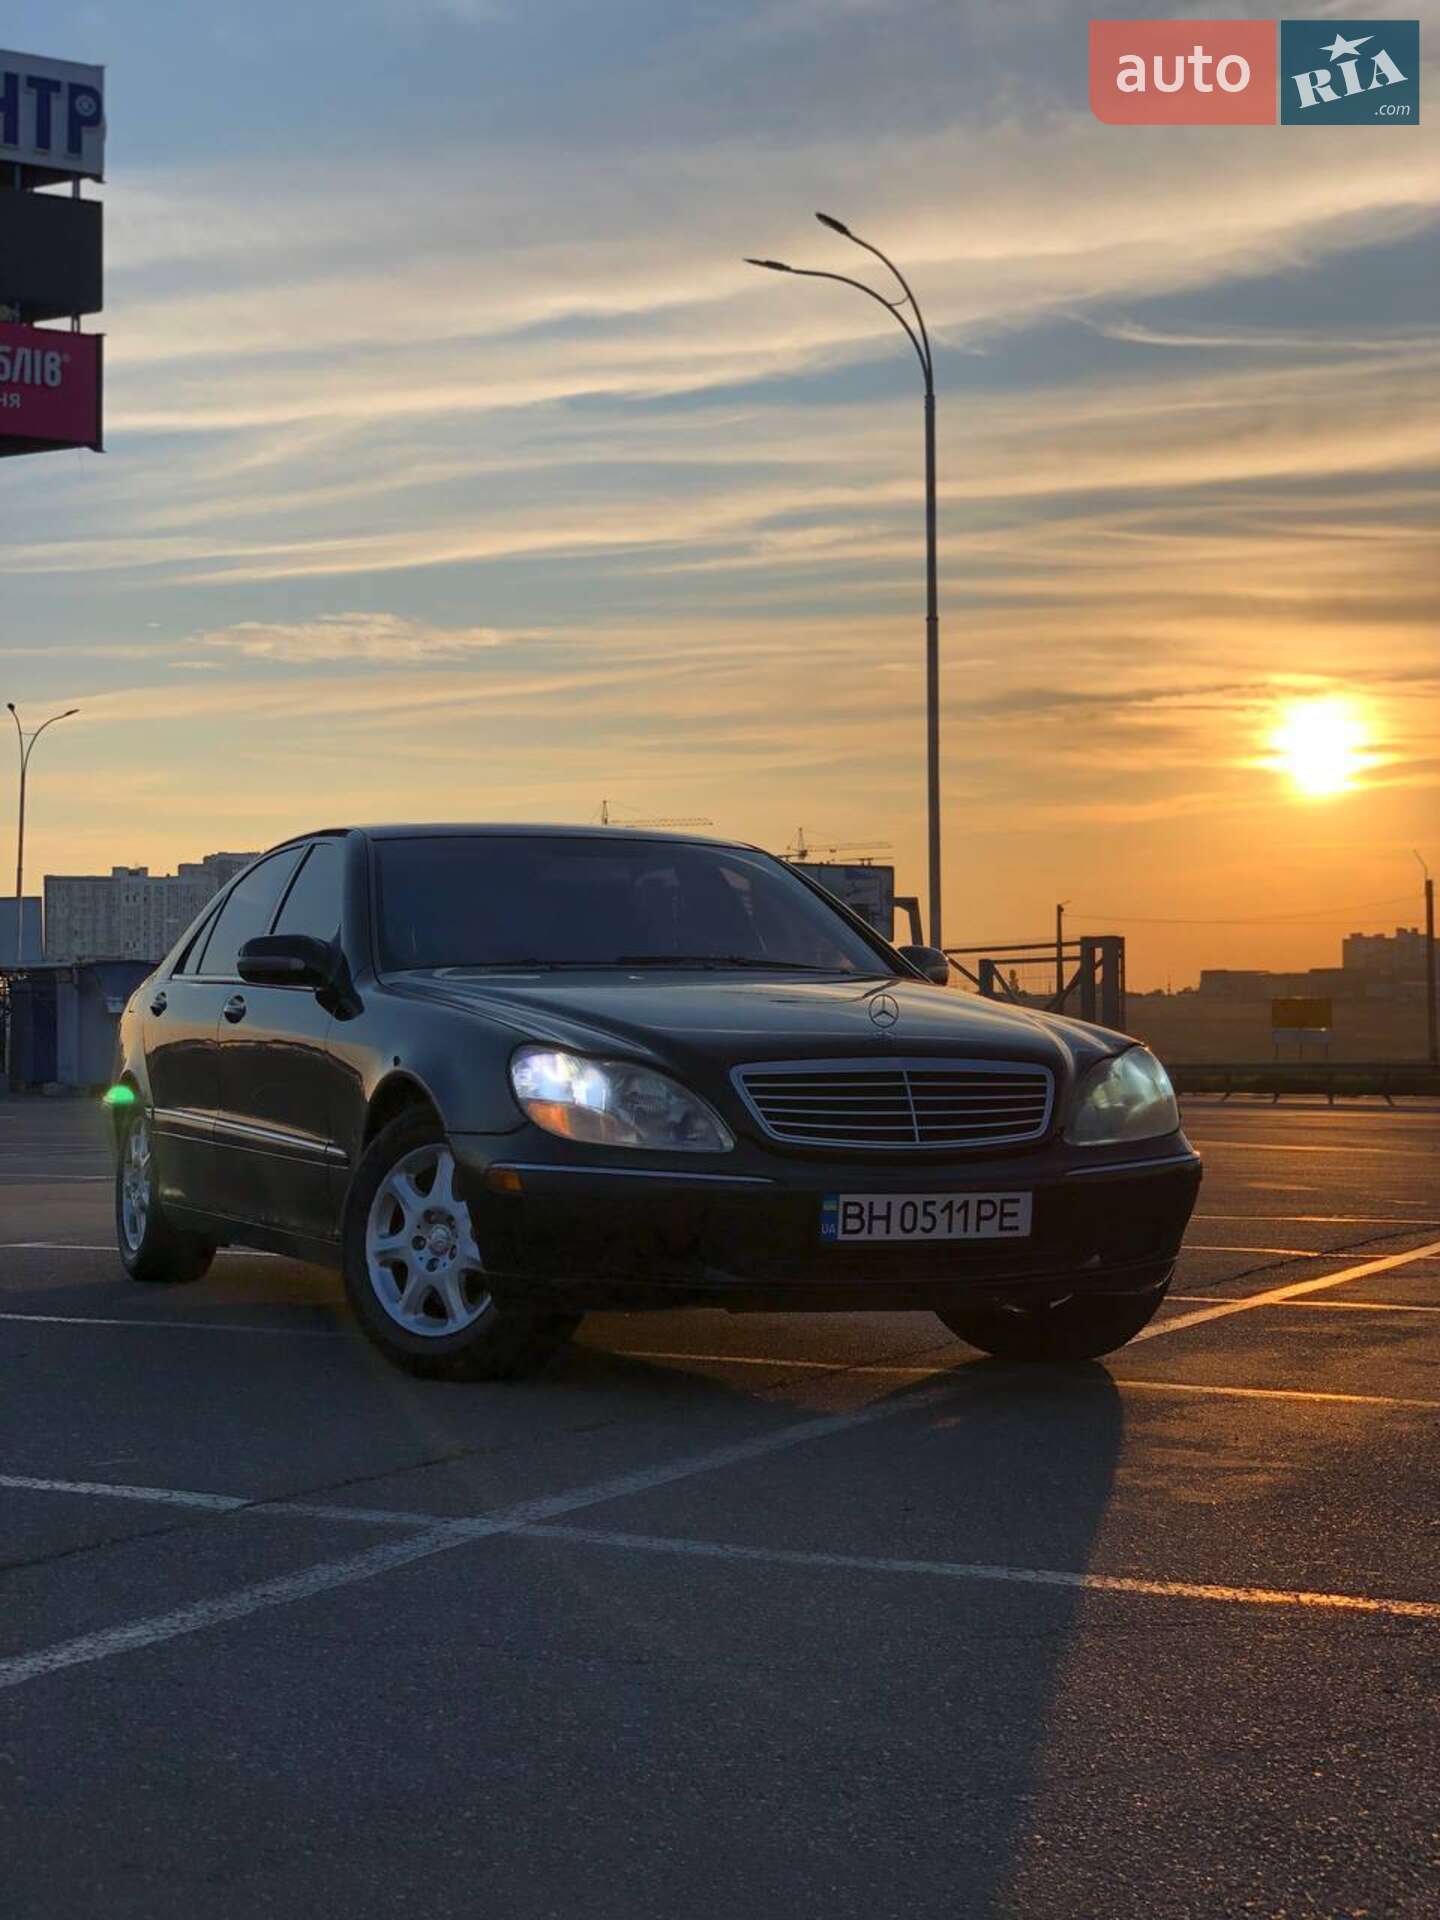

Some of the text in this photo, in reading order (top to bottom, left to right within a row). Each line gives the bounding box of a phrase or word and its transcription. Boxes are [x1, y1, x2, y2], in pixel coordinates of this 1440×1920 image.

[841, 1201, 891, 1236] BH
[901, 1200, 969, 1234] 0511
[975, 1198, 1021, 1233] PE
